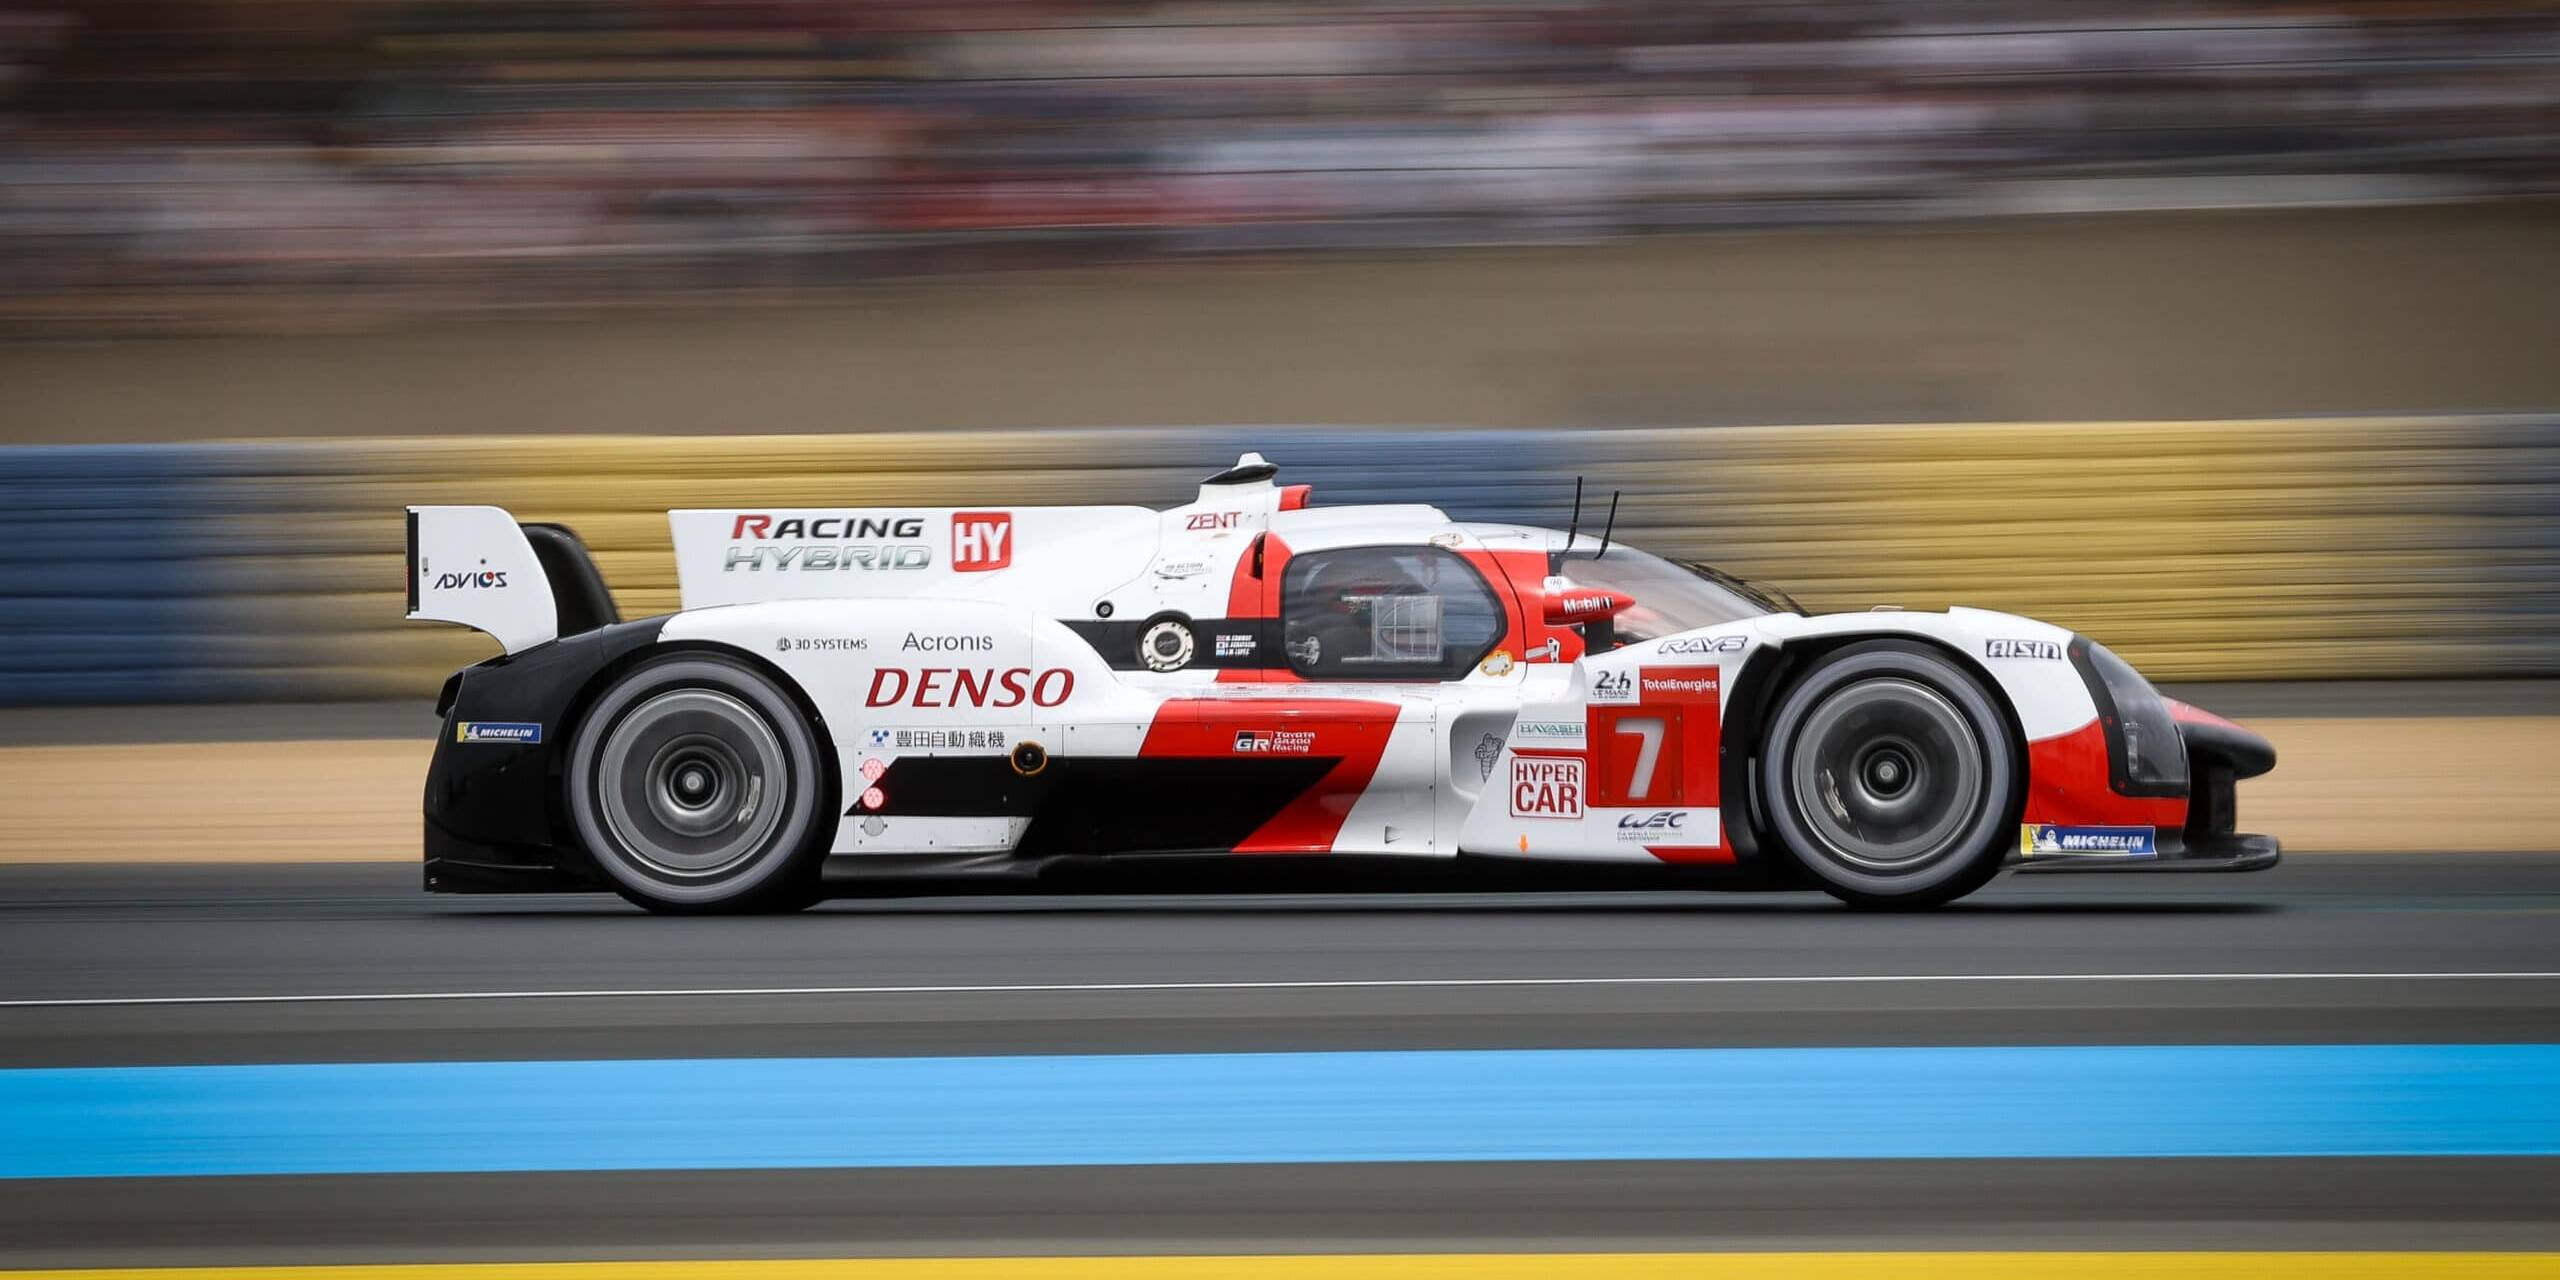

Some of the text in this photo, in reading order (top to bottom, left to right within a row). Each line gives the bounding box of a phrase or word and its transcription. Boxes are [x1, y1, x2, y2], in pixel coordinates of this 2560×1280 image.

[732, 514, 925, 539] RACING
[1186, 511, 1242, 530] ZENT
[954, 522, 1008, 563] HY
[724, 545, 932, 571] HYBRID
[1563, 596, 1600, 614] Mobil
[795, 638, 868, 650] 3D SYSTEMS
[902, 632, 993, 651] Acronis
[1658, 635, 1748, 653] RAYS
[1985, 639, 2062, 659] AISIN
[865, 668, 1075, 707] DENSO
[1642, 679, 1718, 693] TotalEnergies
[480, 728, 533, 737] MICHELIN
[1235, 738, 1270, 752] GR
[1615, 716, 1665, 799] 7
[1516, 763, 1578, 782] HYPER
[1515, 782, 1578, 813] CAR
[1618, 811, 1688, 828] WEC
[2062, 835, 2144, 849] MICHELIN
